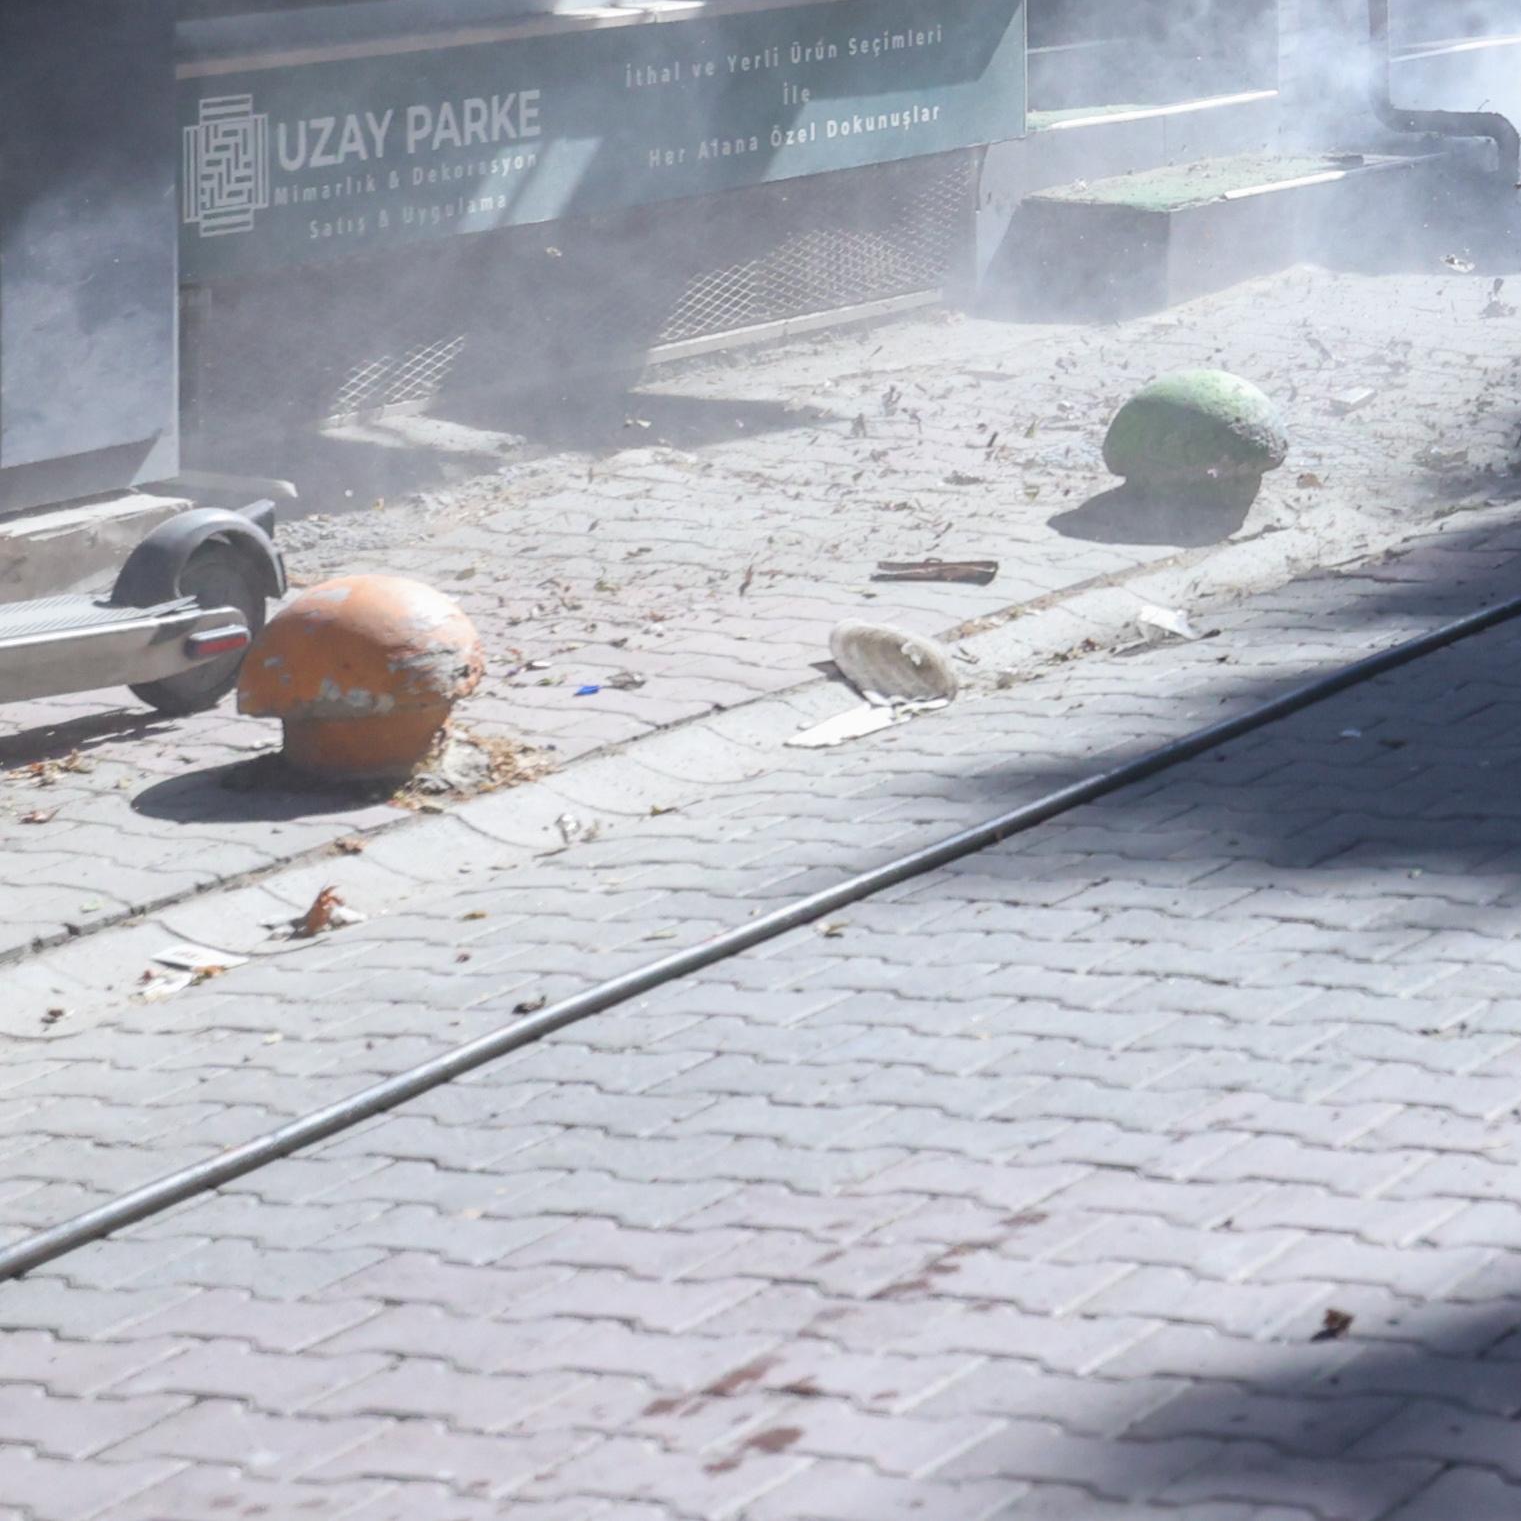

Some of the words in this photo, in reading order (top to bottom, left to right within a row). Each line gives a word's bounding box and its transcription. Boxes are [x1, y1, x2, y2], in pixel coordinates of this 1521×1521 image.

[625, 60, 681, 89] İthal
[692, 61, 715, 79] ve
[727, 47, 779, 73] Yerli
[790, 37, 838, 65] Ürün
[847, 23, 943, 58] Seçimleri
[782, 81, 811, 106] İle
[276, 108, 394, 172] UZAY
[406, 88, 542, 155] PARKE
[649, 146, 686, 168] Her
[698, 132, 758, 159] Alana
[771, 120, 816, 148] Özel
[826, 104, 940, 139] Dokunuşlar
[273, 172, 377, 207] Mimarlık
[389, 170, 399, 188] &
[412, 151, 538, 187] Dekorasyon
[308, 208, 367, 240] Satış
[378, 208, 390, 229] &
[404, 193, 508, 225] Uygulama
